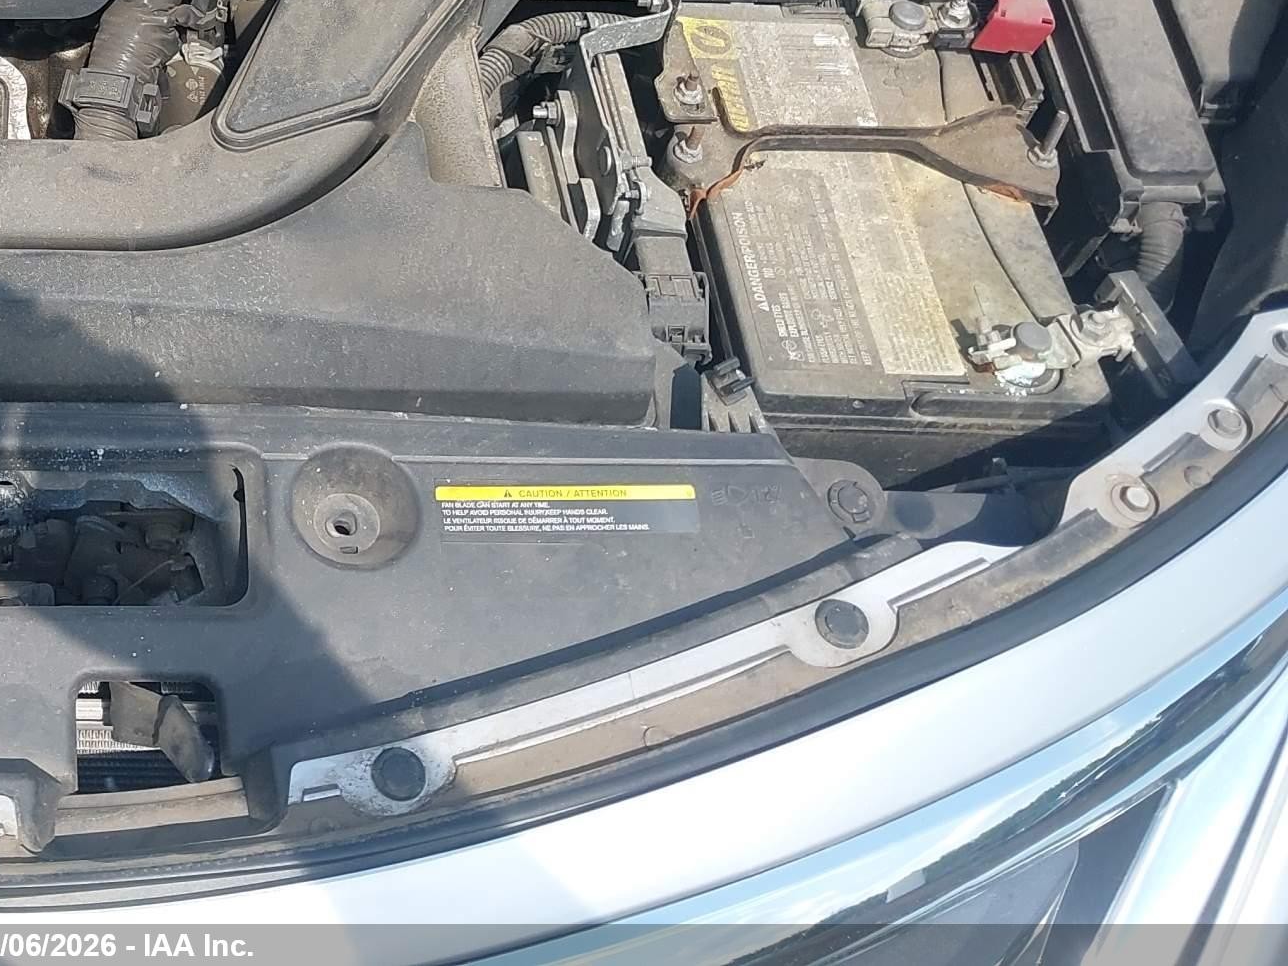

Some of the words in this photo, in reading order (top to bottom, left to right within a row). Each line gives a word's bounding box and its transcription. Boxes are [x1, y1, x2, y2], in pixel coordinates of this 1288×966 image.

[731, 211, 766, 302] DANGER/POISON
[771, 304, 783, 318] EYES
[775, 319, 789, 338] SHIELD
[518, 489, 564, 498] CAUTION
[574, 488, 627, 498] ATTENTION
[476, 501, 491, 509] CAN
[586, 508, 608, 516] CLEAR.
[528, 516, 562, 524] DÉMARRER
[463, 524, 485, 532] ÉVITER
[628, 523, 650, 531] MAINS.
